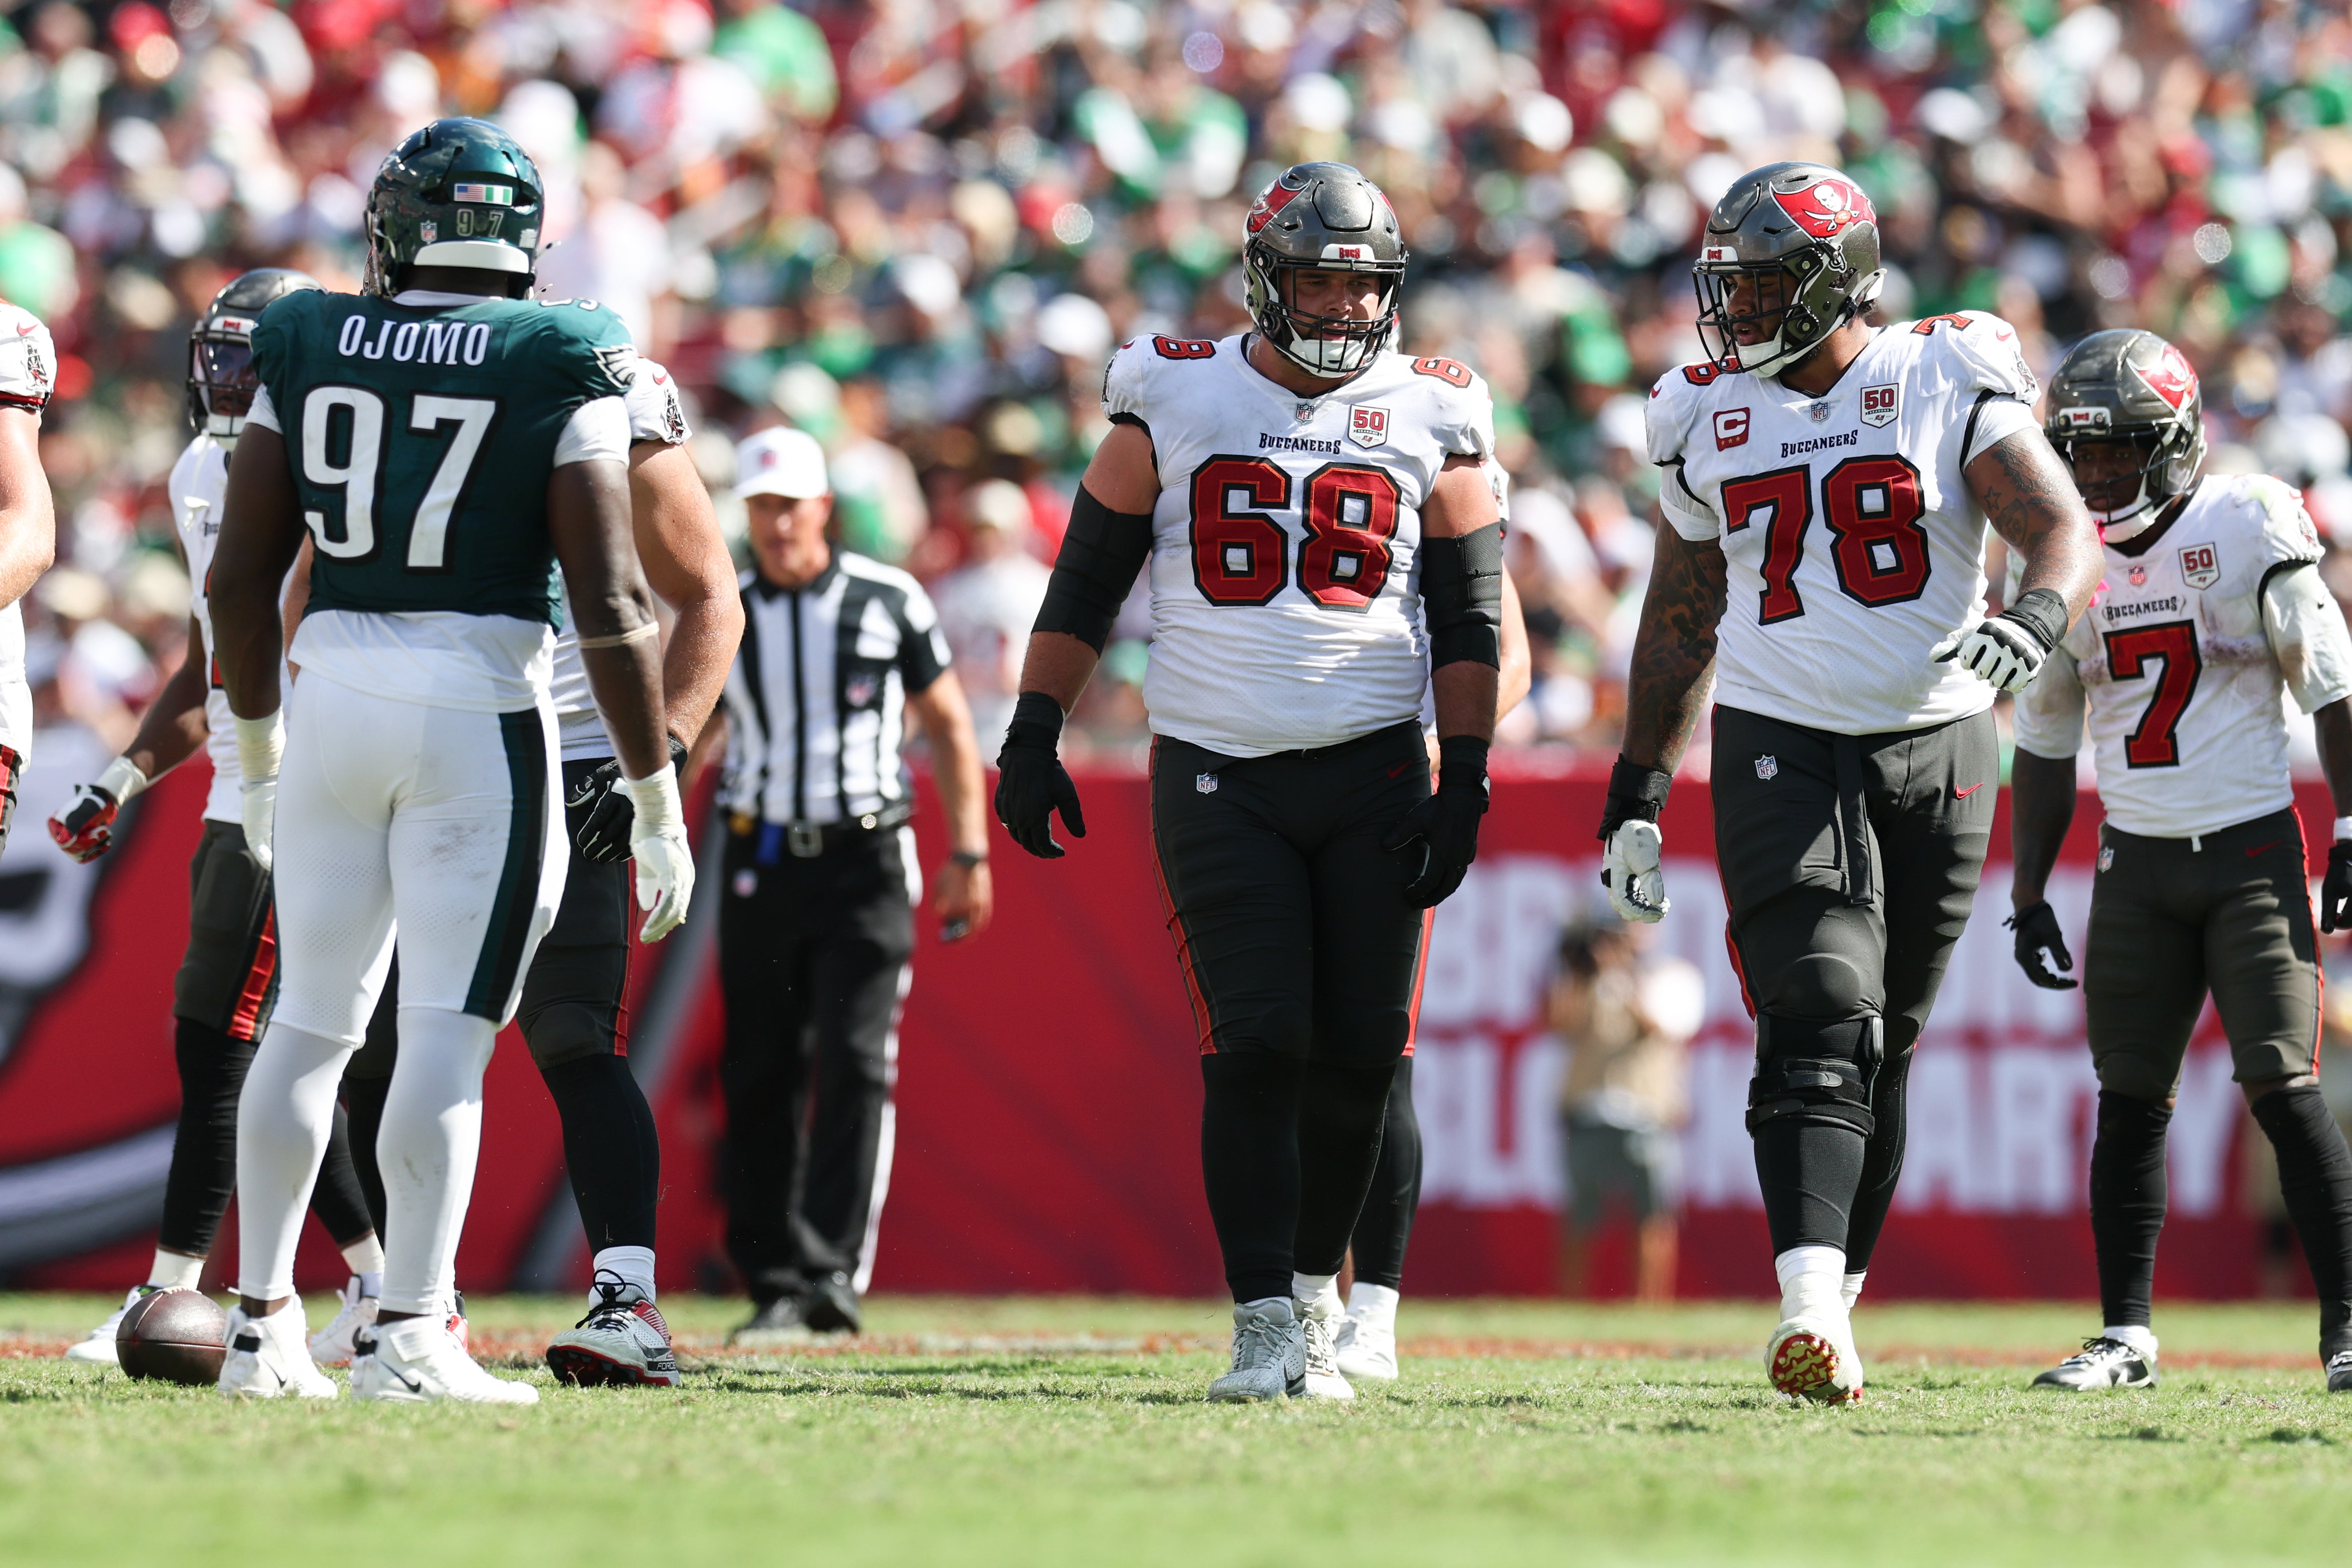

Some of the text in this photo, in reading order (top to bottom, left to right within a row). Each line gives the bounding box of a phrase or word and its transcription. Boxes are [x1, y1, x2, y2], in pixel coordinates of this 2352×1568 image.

[456, 208, 505, 238] 97
[338, 315, 493, 367] OJOMO
[1864, 388, 1894, 410] 50
[1353, 409, 1384, 431] 50
[1716, 410, 1747, 439] C
[1813, 409, 1826, 419] NFL
[1259, 432, 1341, 455] BUCCANEERS
[1781, 429, 1858, 458] BUCCANEERS
[301, 382, 501, 574] 97
[1190, 454, 1402, 613] 68
[1720, 453, 1932, 626] 78
[2183, 548, 2213, 571] 50
[2106, 596, 2177, 621] BUCCANEERS
[2103, 619, 2202, 769] 7
[1760, 765, 1774, 775] NFL
[657, 1362, 676, 1370] FORCE
